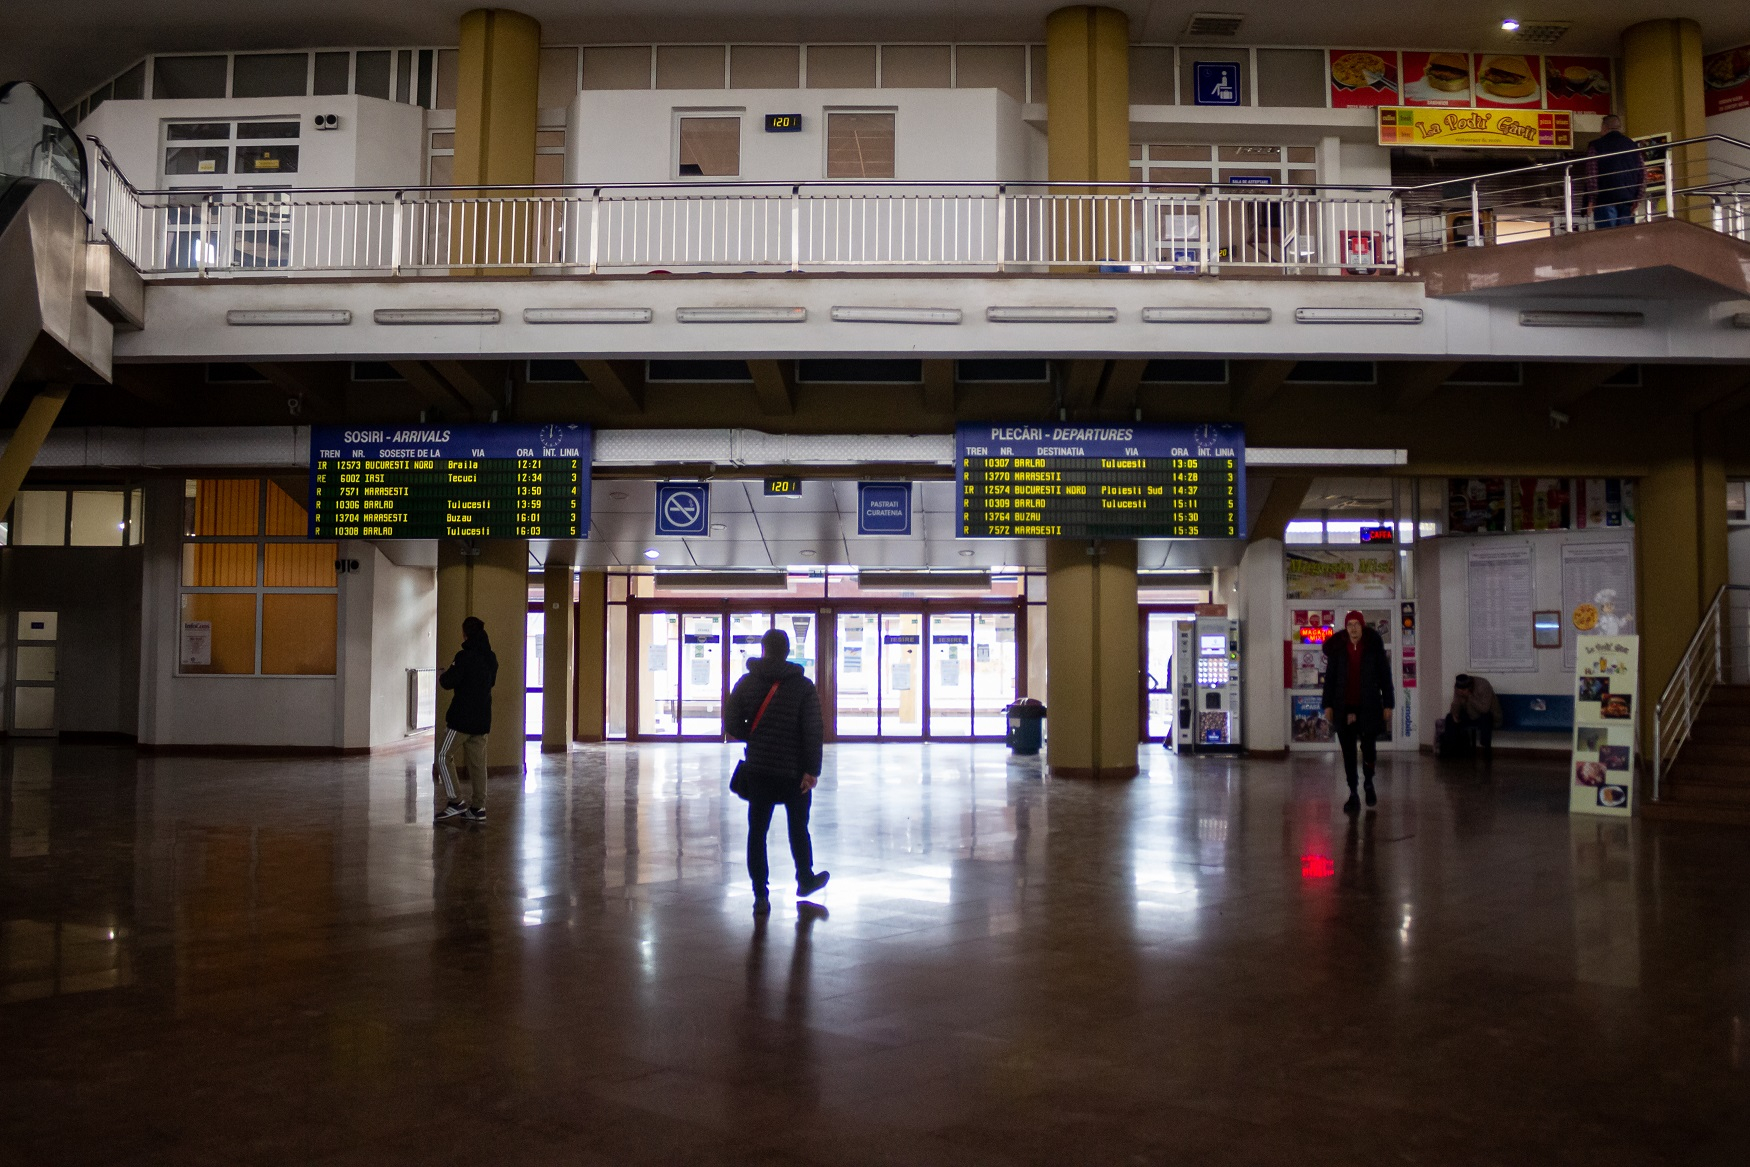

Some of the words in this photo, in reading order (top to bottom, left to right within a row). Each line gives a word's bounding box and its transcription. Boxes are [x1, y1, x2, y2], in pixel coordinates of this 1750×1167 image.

[1415, 121, 1442, 140] La
[345, 431, 383, 442] SOSIRI
[393, 430, 450, 442] ARRIVALS
[992, 426, 1042, 440] PLECĂRI
[1053, 429, 1133, 440] DEPARTURES
[320, 450, 340, 458] TREN
[353, 450, 365, 458] NR.
[418, 449, 428, 457] DE
[430, 449, 440, 457] LA
[472, 449, 485, 457] VIA
[517, 449, 533, 457] ORA
[543, 447, 556, 457] ÎNT.
[560, 449, 579, 457] LINIA
[966, 447, 988, 456] TREN
[1001, 447, 1014, 456] NR.
[1125, 448, 1138, 456] VIA
[1171, 448, 1188, 456] ORA
[1198, 446, 1211, 456] ÎNT.
[1215, 448, 1234, 456] LINIA
[318, 460, 327, 470] IR
[338, 460, 361, 470] 12573
[365, 460, 409, 470] BUCURESTI
[414, 460, 433, 470] NORD
[448, 460, 478, 470] Braila
[518, 460, 541, 470] 12:21
[572, 460, 577, 470] 2
[964, 459, 969, 468] R
[984, 459, 1010, 468] 10307
[1014, 459, 1045, 468] BARLAD
[1102, 459, 1146, 468] Tulucesti
[1173, 459, 1198, 468] 13:05
[1227, 459, 1232, 468] 5
[317, 474, 326, 483] RE
[341, 474, 360, 483] 6002
[365, 474, 384, 483] IASI
[448, 474, 477, 483] Tecuci
[518, 474, 542, 483] 12:34
[571, 473, 577, 483] 3
[964, 472, 969, 481] R
[984, 472, 1010, 481] 13770
[1014, 472, 1061, 481] MARASESTI
[1173, 472, 1198, 482] 14:28
[1228, 472, 1233, 481] 3
[316, 487, 321, 496] R
[340, 487, 359, 496] 7571
[364, 487, 409, 496] MARASESTI
[517, 487, 541, 496] 13:50
[571, 486, 577, 496] 4
[964, 486, 974, 494] IR
[985, 486, 1010, 494] 12574
[1014, 486, 1061, 494] BUCURESTI
[1066, 486, 1086, 494] NORD
[1101, 486, 1142, 495] Ploiesti
[1147, 486, 1162, 495] Sud
[1173, 486, 1198, 495] 14:37
[1228, 486, 1233, 495] 2
[316, 500, 321, 509] R
[335, 500, 359, 509] 10306
[364, 500, 393, 509] BARLAD
[448, 500, 491, 509] Tulucesti
[517, 500, 541, 509] 13:59
[570, 500, 576, 509] 5
[964, 499, 969, 508] R
[985, 499, 1010, 508] 10309
[1014, 499, 1045, 508] BARLAD
[1102, 499, 1147, 508] Tulucesti
[1173, 499, 1198, 508] 15:11
[1228, 499, 1234, 508] 5
[316, 513, 321, 522] R
[335, 513, 359, 522] 13704
[364, 513, 408, 522] MARASESTI
[447, 513, 472, 522] Buzau
[516, 513, 540, 522] 16:01
[570, 513, 576, 522] 3
[964, 512, 969, 521] R
[984, 512, 1010, 521] 13764
[1014, 512, 1041, 521] BUZAU
[1173, 512, 1198, 522] 15:30
[1228, 512, 1234, 521] 2
[315, 527, 320, 536] R
[335, 527, 358, 536] 10308
[363, 527, 392, 536] BARLAD
[447, 527, 490, 536] Tulucesti
[516, 527, 541, 536] 16:03
[570, 527, 575, 536] 5
[964, 526, 969, 534] R
[989, 526, 1010, 534] 7572
[1014, 526, 1061, 535] MARASESTI
[1174, 526, 1199, 535] 15:35
[1228, 526, 1234, 534] 3
[1301, 629, 1334, 637] MAGAZIN
